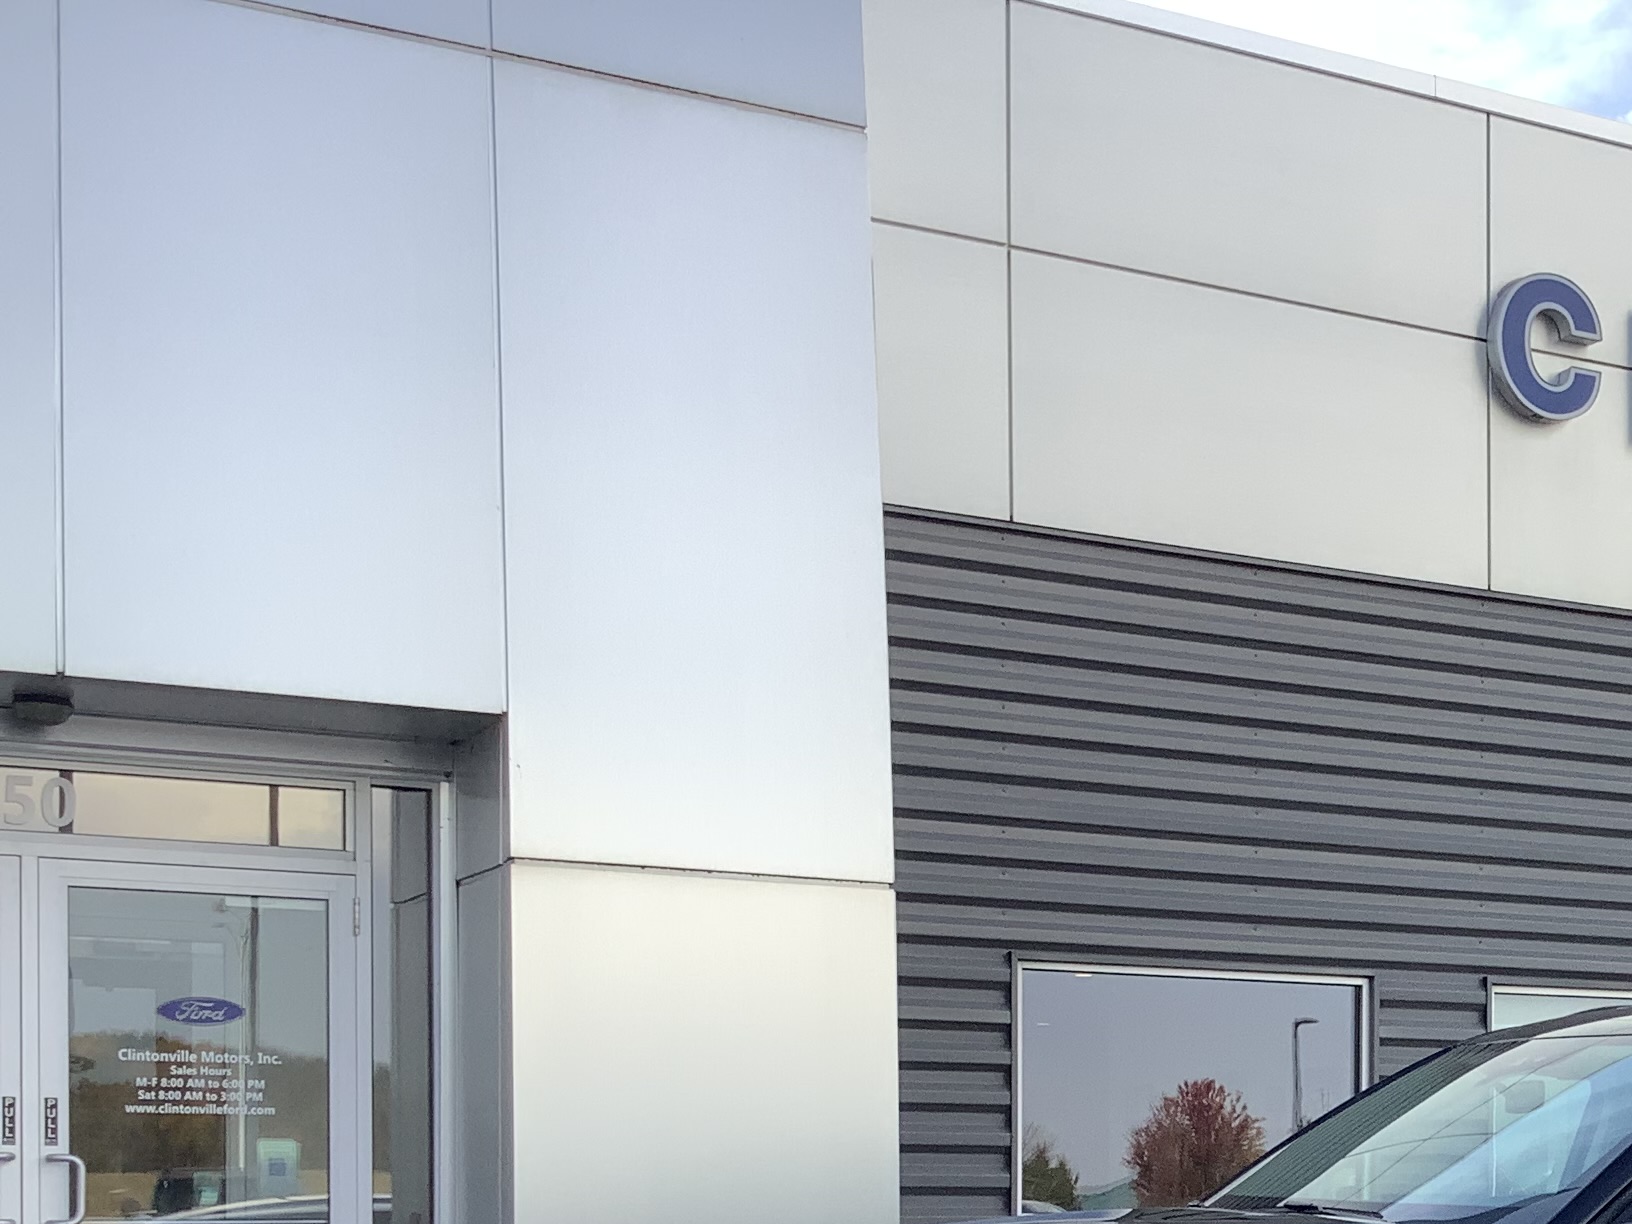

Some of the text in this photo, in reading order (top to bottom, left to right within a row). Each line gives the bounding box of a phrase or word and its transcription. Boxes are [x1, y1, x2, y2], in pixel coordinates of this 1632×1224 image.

[4, 775, 76, 828] 50
[175, 1000, 229, 1022] Ford
[117, 1048, 282, 1066] Clintonville Motors, Inc.
[169, 1065, 232, 1076] Sales Hours
[135, 1077, 158, 1087] M-F
[160, 1078, 184, 1088] 8:00
[186, 1079, 205, 1089] AM
[208, 1079, 220, 1089] to
[247, 1080, 266, 1090] PM
[137, 1089, 264, 1102] Sat 8:00 AM to 3:00 PM
[4, 1097, 14, 1137] PULL
[46, 1098, 56, 1138] PULL
[124, 1103, 276, 1116] www.clintonvilleford.com
